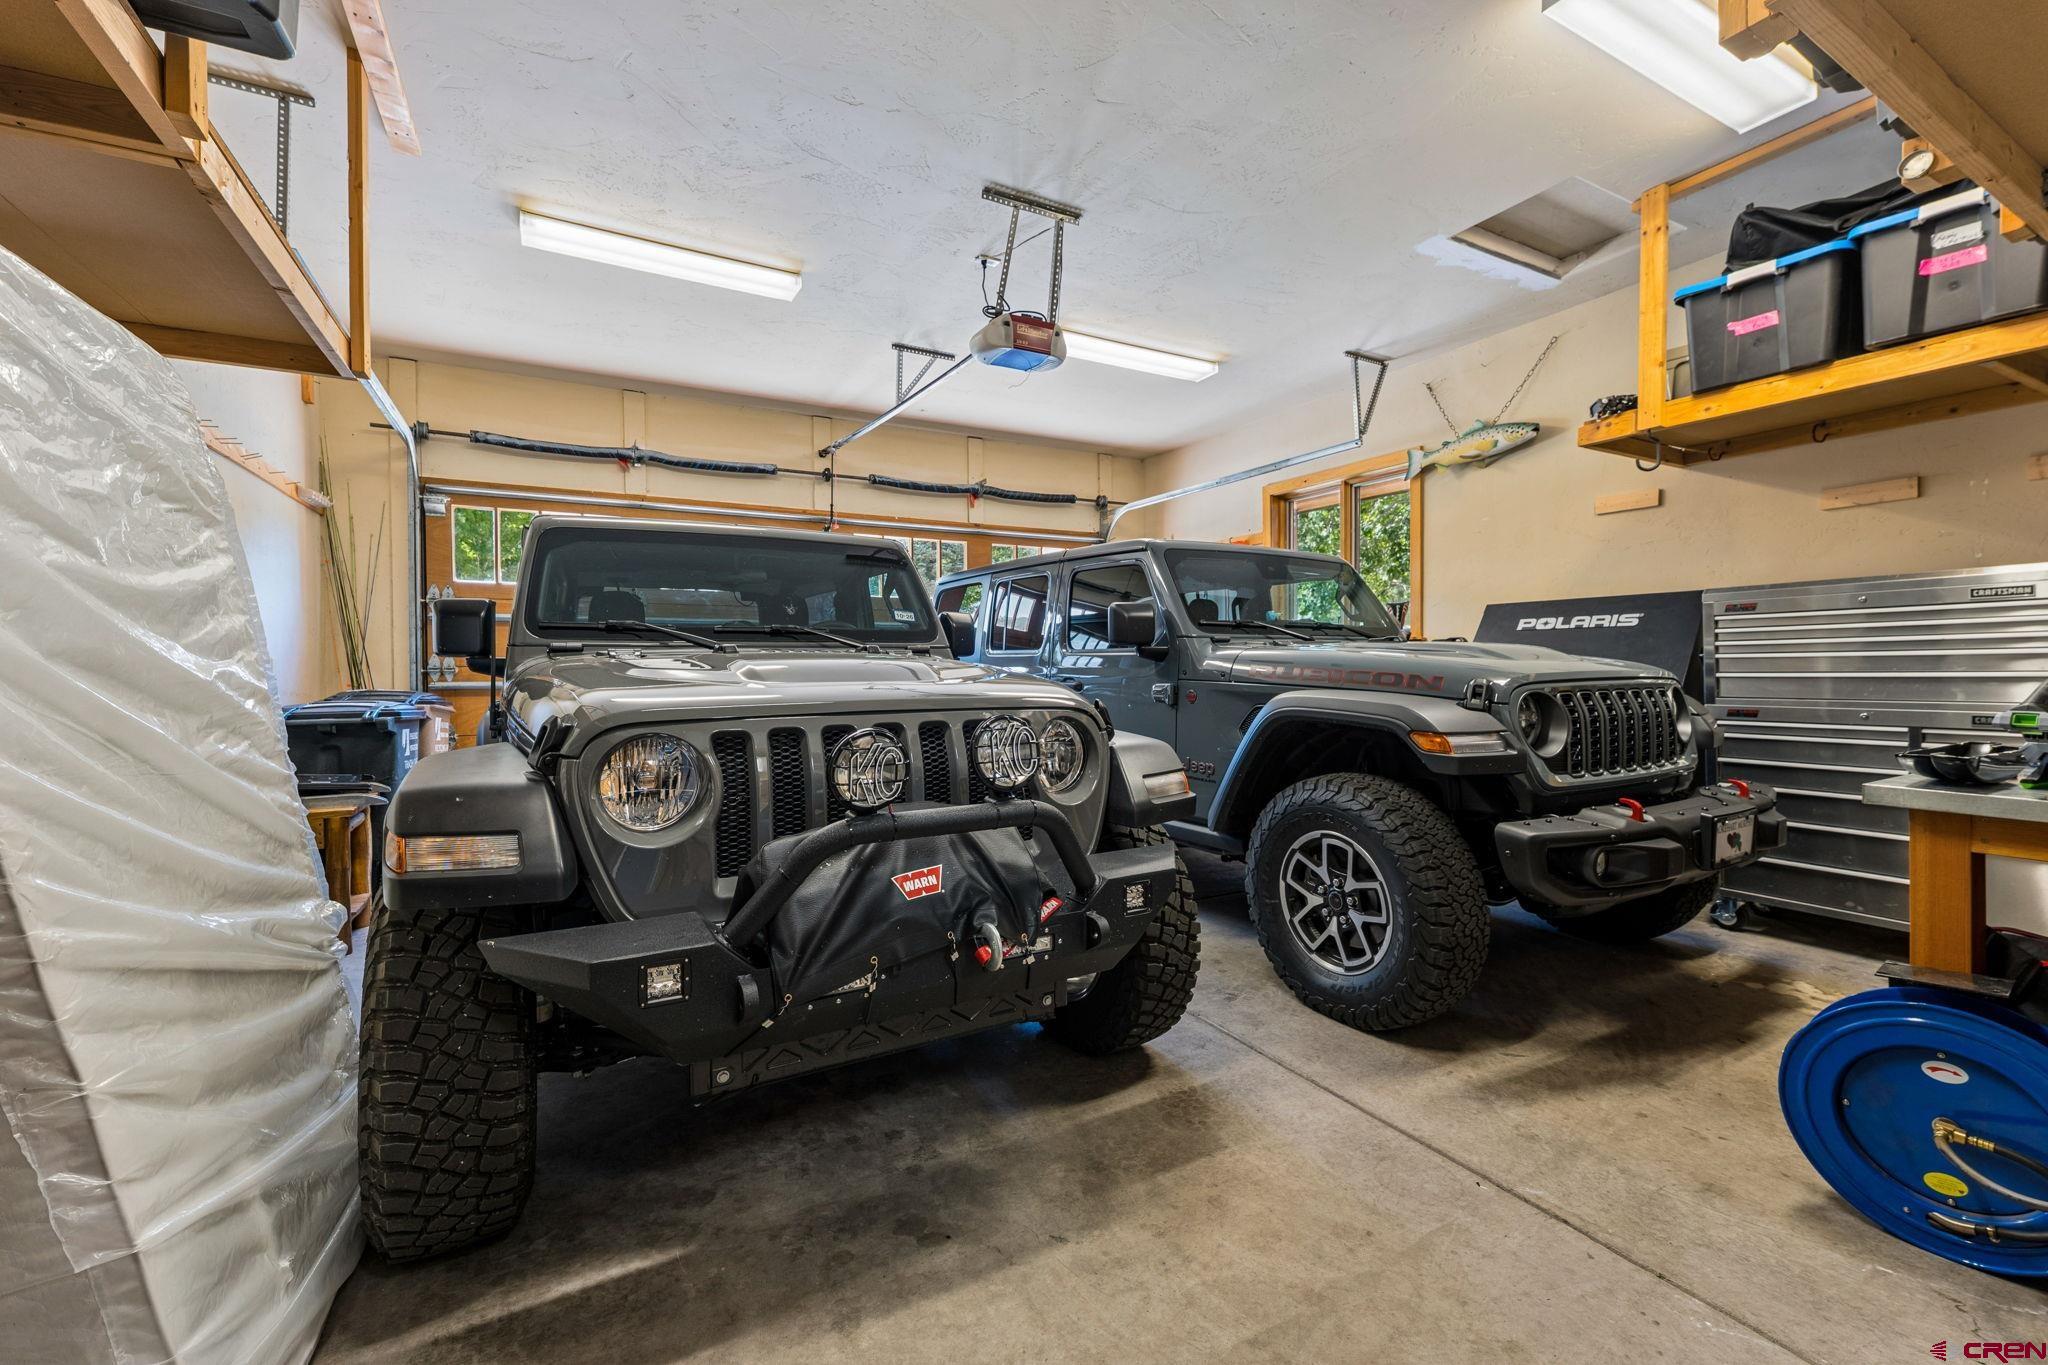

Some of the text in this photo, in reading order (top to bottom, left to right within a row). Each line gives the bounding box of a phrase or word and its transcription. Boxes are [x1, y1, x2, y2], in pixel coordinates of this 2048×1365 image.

[1972, 586, 2033, 597] CRAFTSMAN
[1516, 613, 1644, 631] POLARIS
[1248, 664, 1445, 692] RUBICON
[990, 722, 1038, 781] KC
[850, 742, 903, 806] KC
[903, 874, 937, 892] WARN
